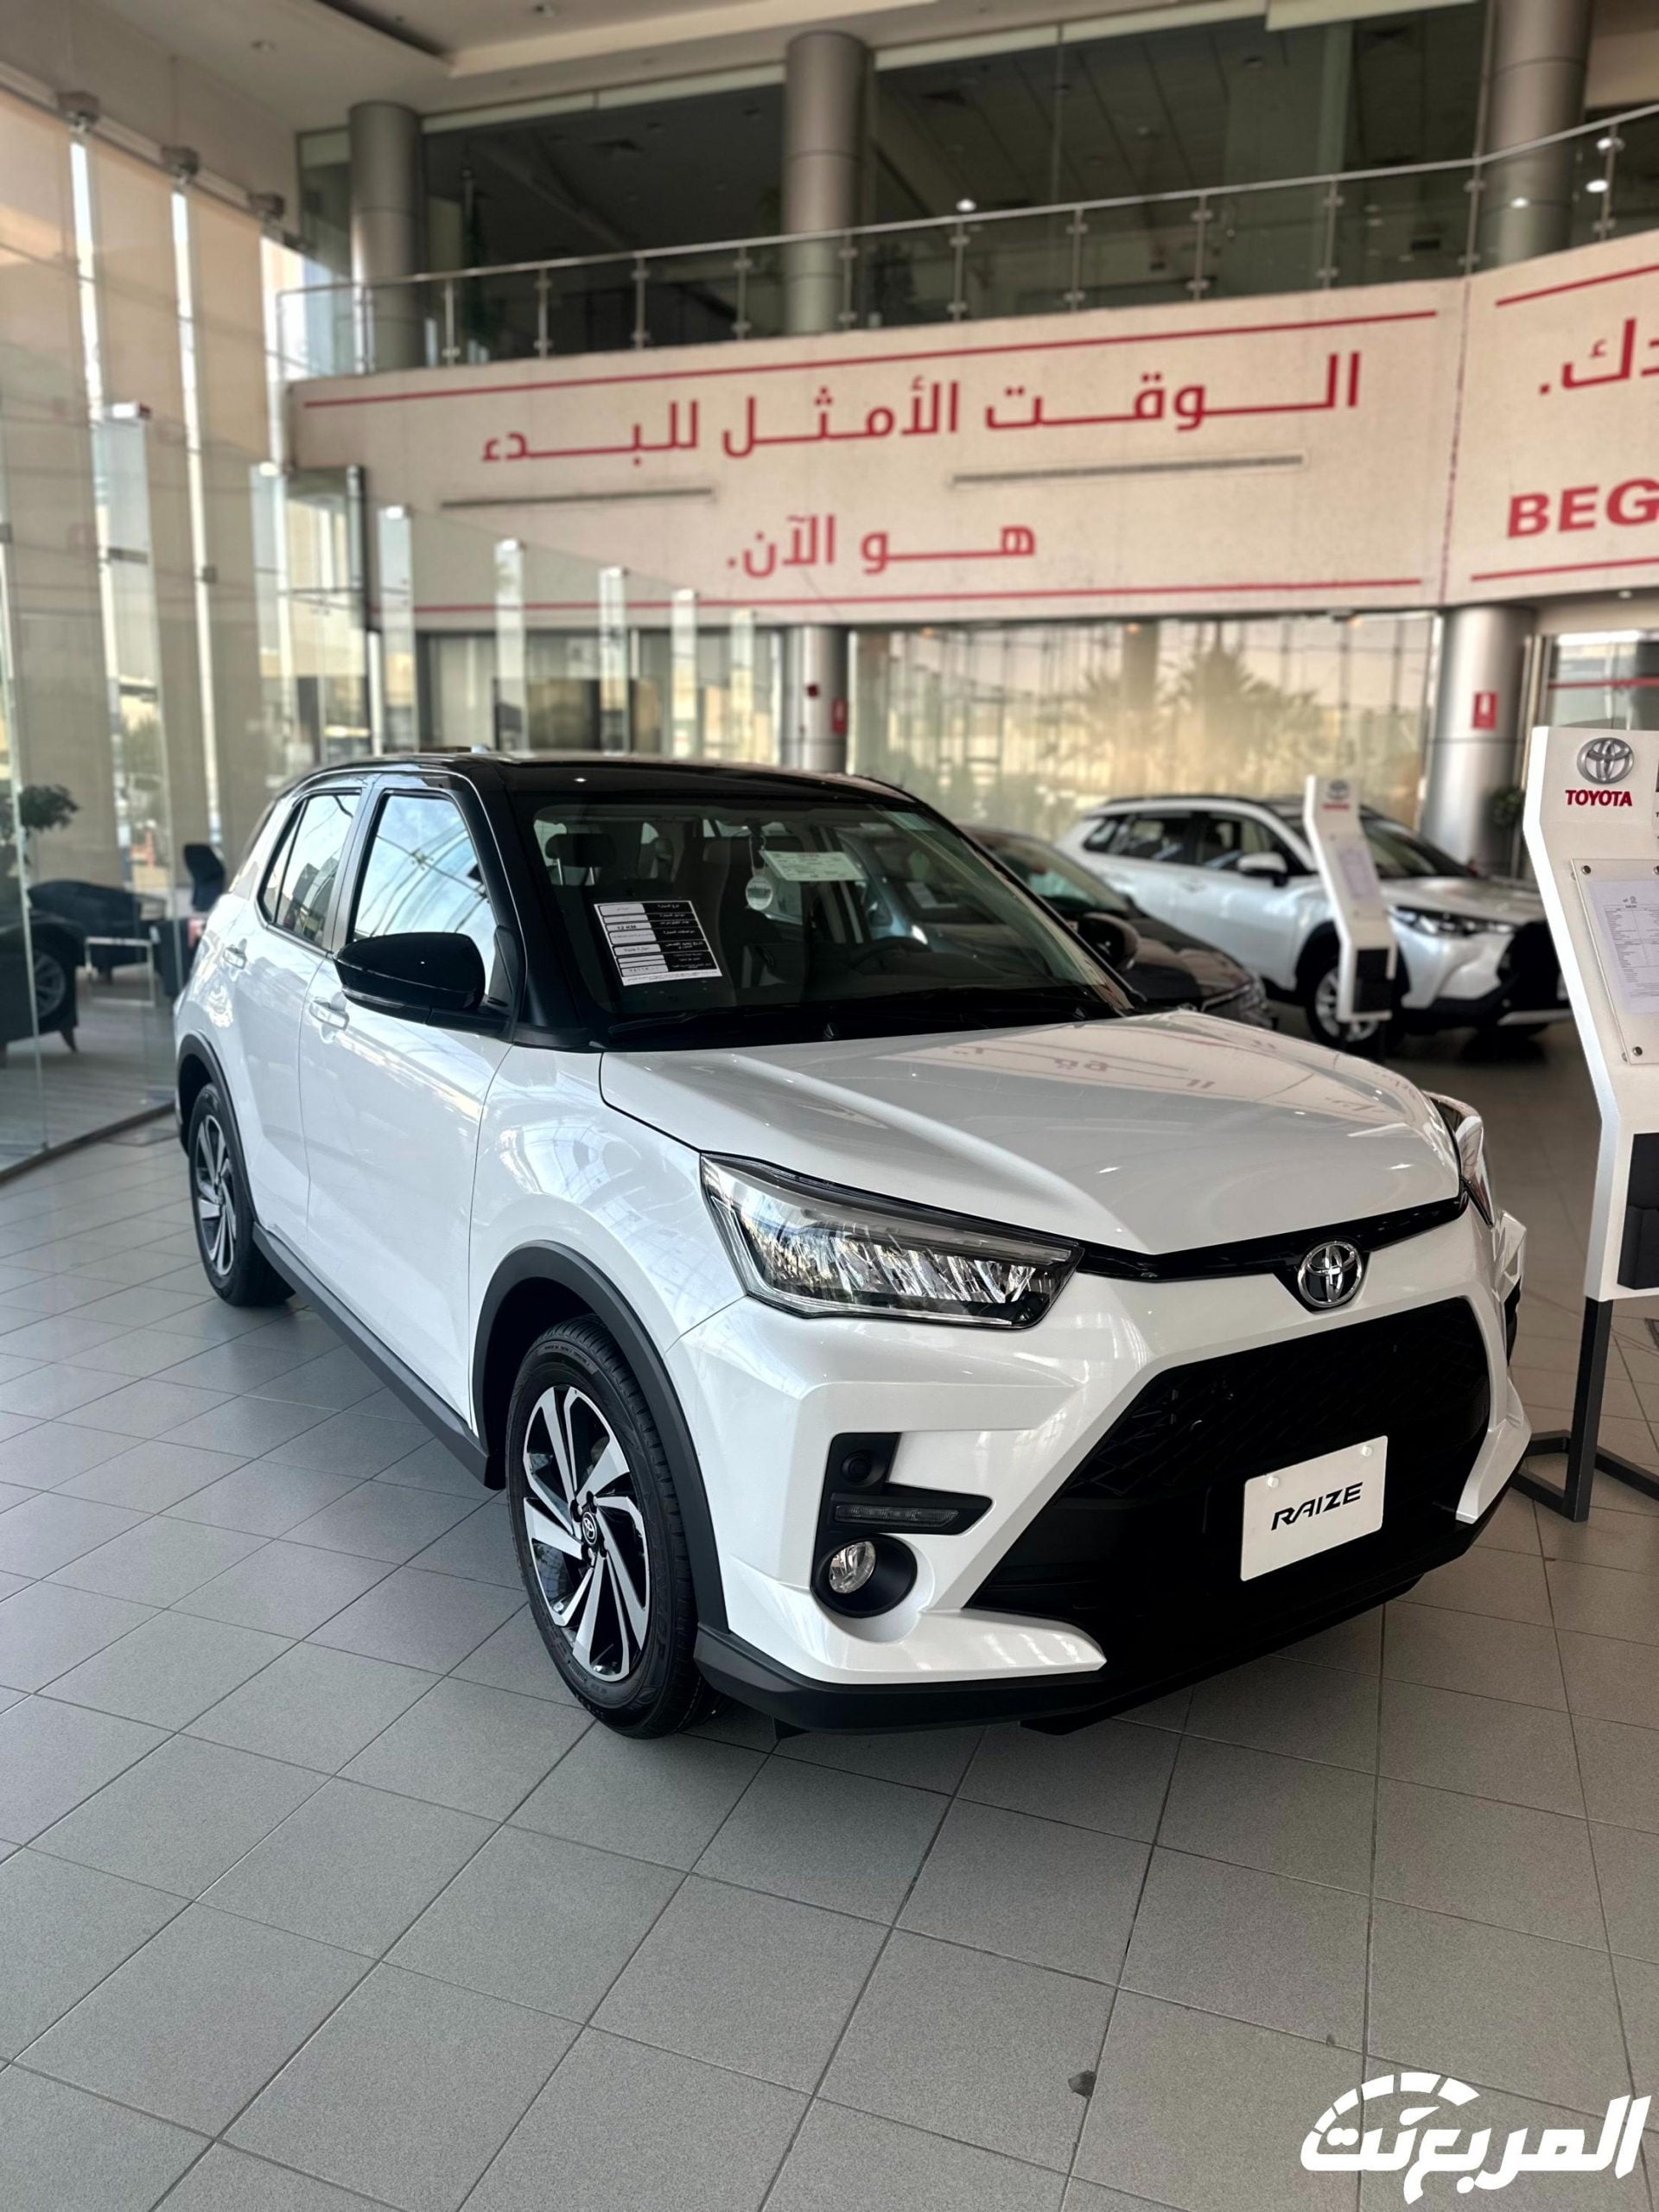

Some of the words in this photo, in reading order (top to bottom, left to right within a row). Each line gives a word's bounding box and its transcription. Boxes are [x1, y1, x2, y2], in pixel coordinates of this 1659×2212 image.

[721, 375, 962, 460] الأمثل
[984, 351, 1363, 435] الوقت
[483, 399, 701, 466] للبدء
[728, 513, 838, 580] الآن.
[860, 524, 1038, 576] هو
[1565, 788, 1633, 807] TOYOTA
[1270, 1481, 1363, 1531] RAIZE
